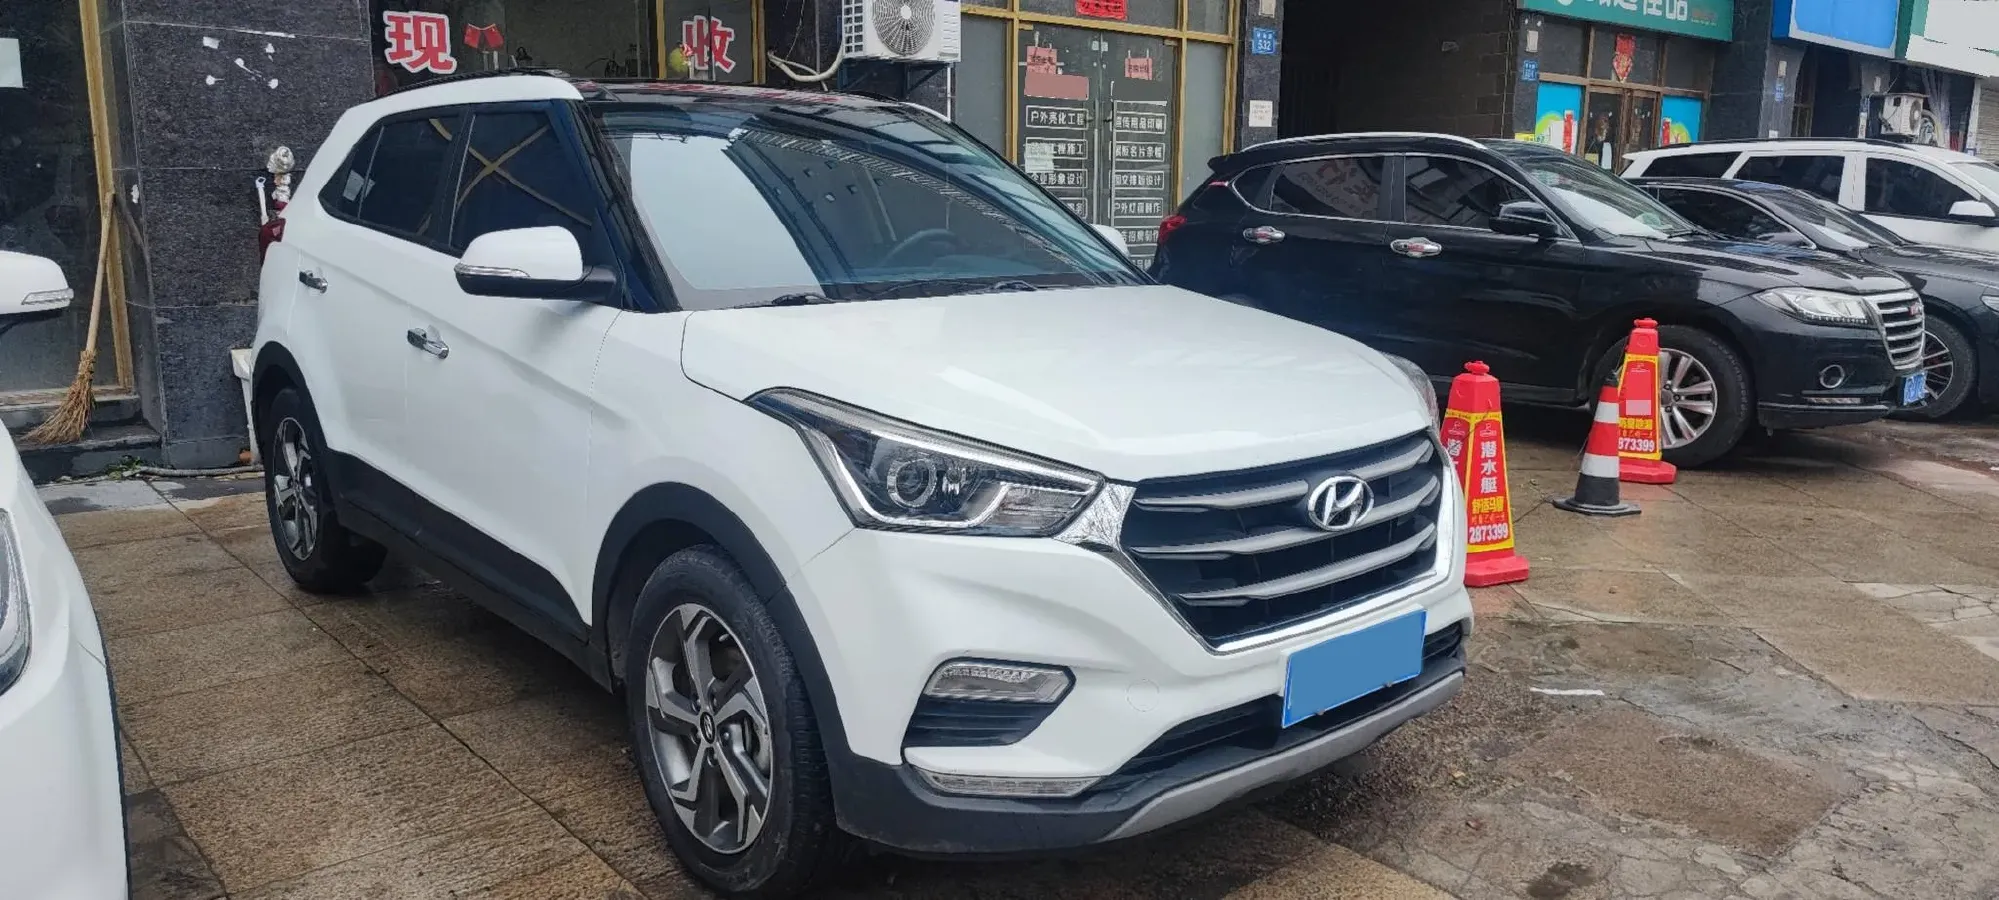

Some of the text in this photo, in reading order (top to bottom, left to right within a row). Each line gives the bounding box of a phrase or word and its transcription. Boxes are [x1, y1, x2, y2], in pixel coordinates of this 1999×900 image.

[383, 11, 457, 74] 现
[683, 15, 736, 73] 收
[1030, 110, 1085, 126] 户外亮化工程
[1618, 436, 1656, 453] 873399
[1481, 440, 1498, 494] 潜水艇
[1469, 522, 1509, 543] 2873399
